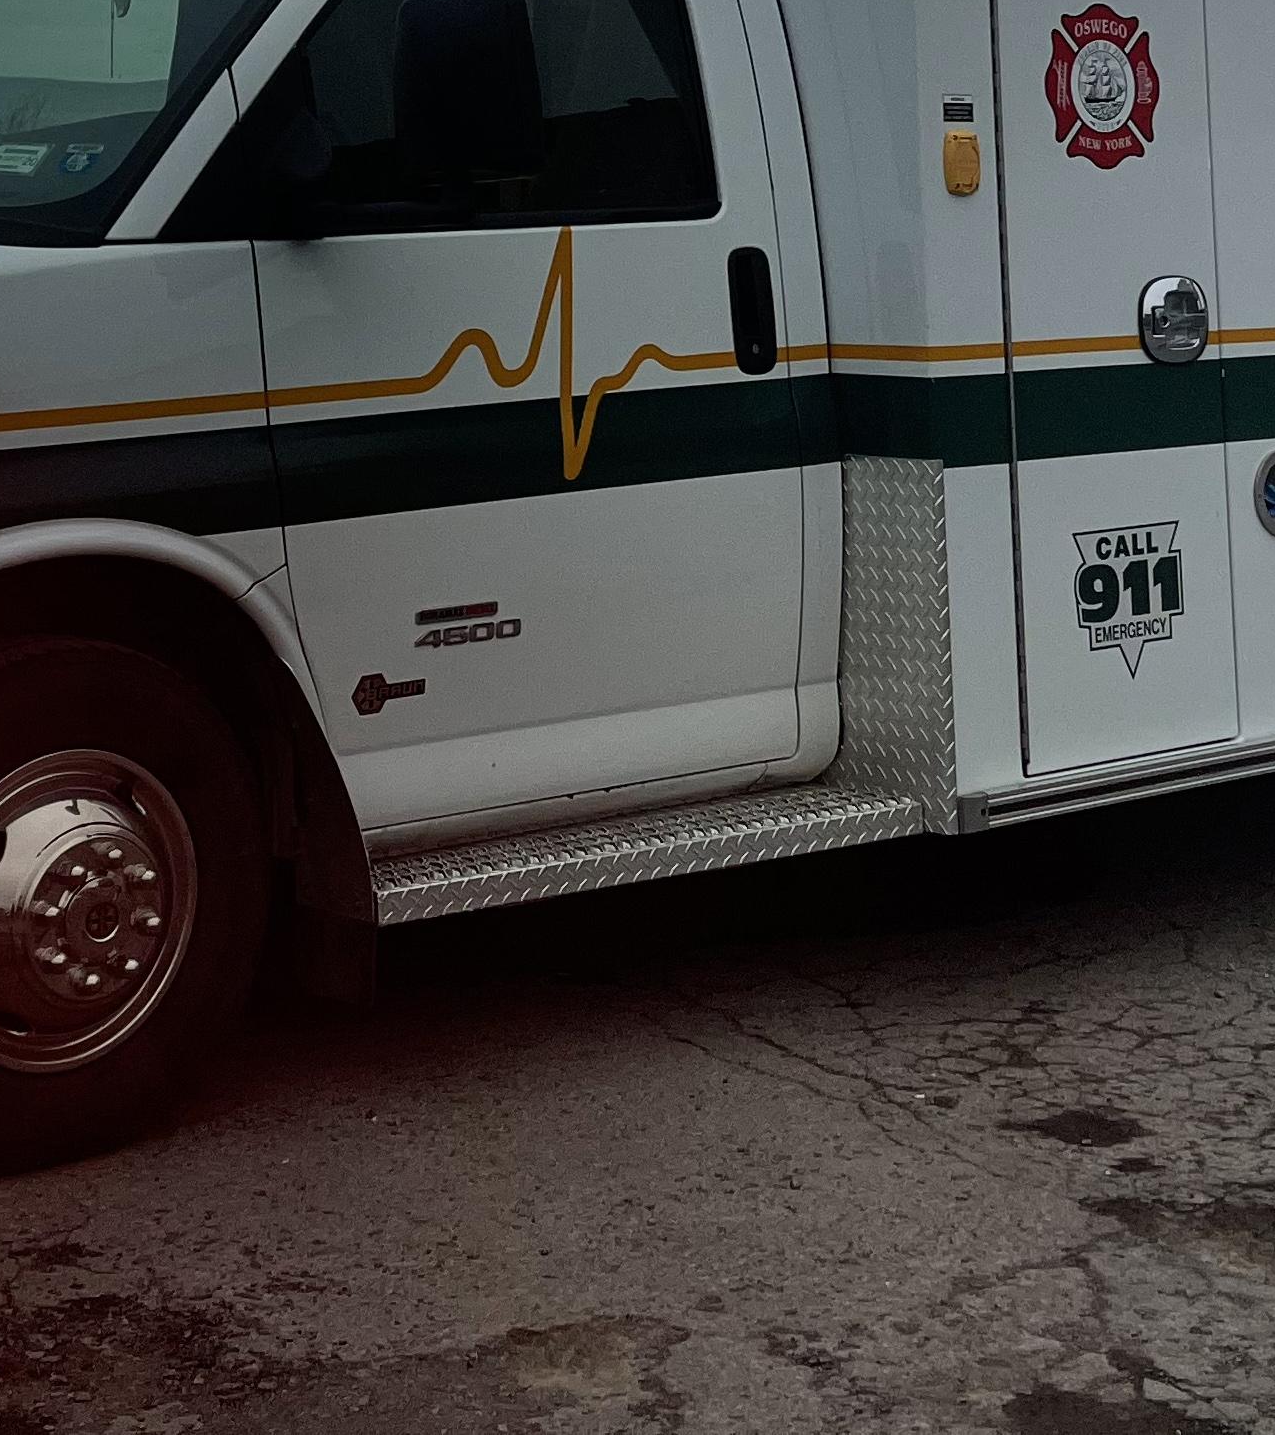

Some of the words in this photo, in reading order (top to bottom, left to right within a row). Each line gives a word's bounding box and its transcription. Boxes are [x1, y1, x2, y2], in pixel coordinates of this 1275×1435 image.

[1074, 18, 1128, 39] OSWEGO
[1078, 135, 1102, 151] NEW
[1105, 135, 1132, 151] YORK
[1095, 531, 1159, 560] CALL
[1078, 555, 1181, 623] 911
[414, 619, 521, 648] 4500
[1095, 617, 1168, 644] EMERGENCY
